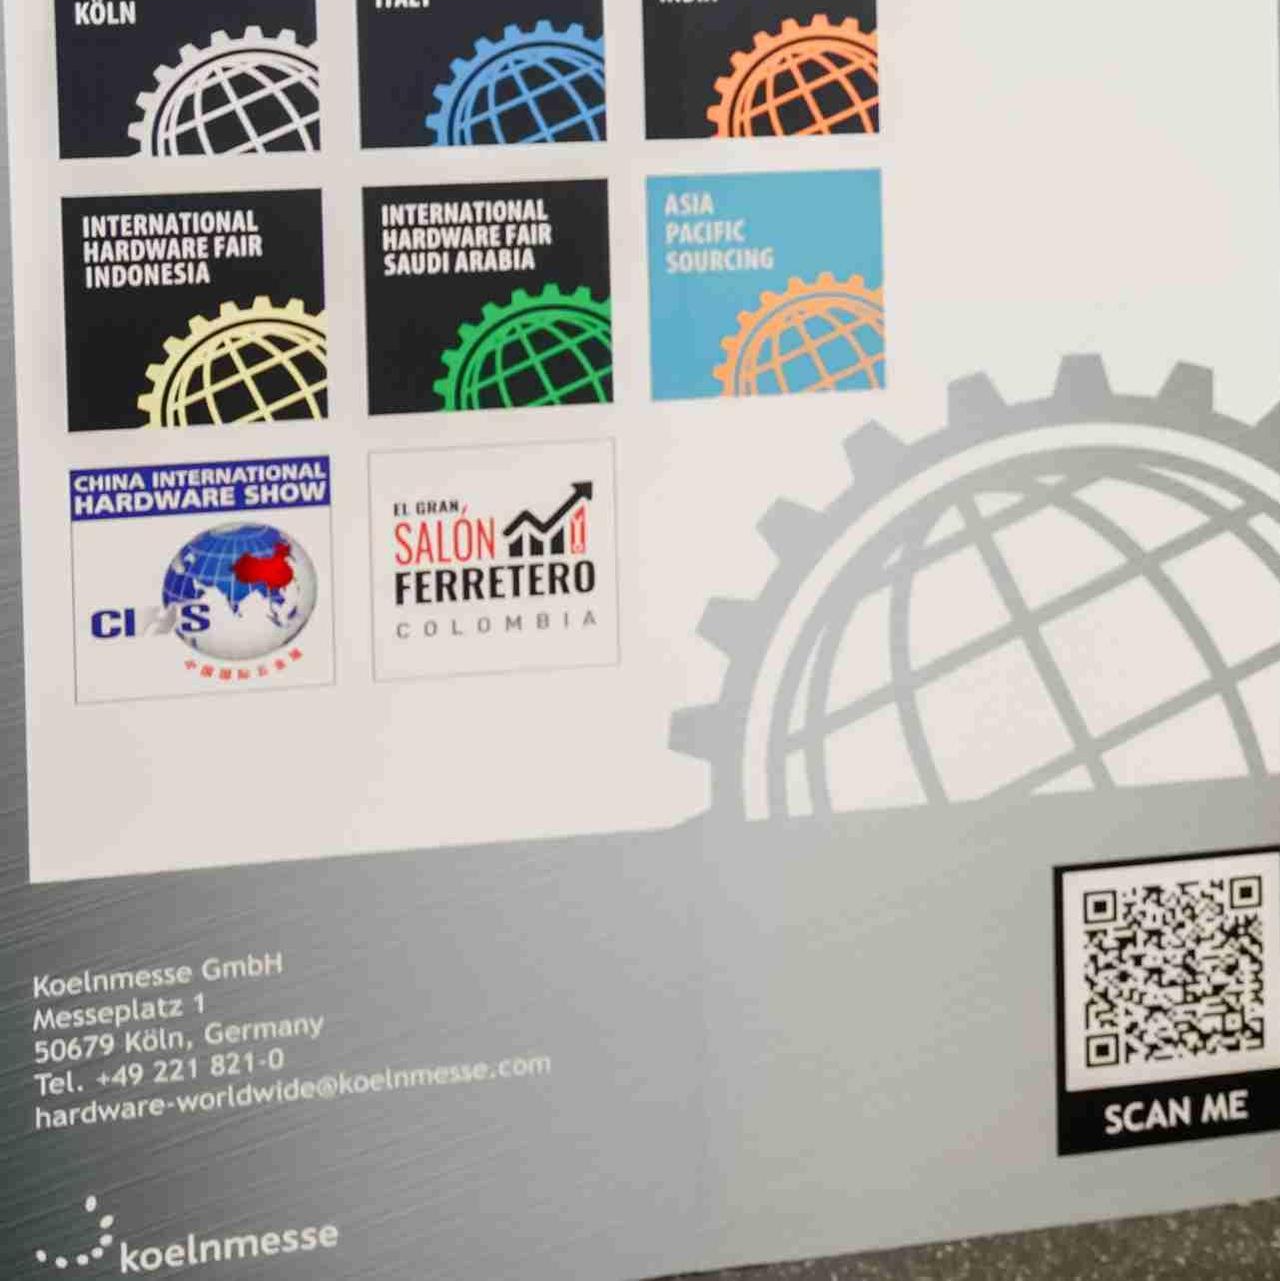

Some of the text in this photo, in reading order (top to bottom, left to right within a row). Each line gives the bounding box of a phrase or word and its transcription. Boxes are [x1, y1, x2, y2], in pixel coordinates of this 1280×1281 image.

[381, 199, 549, 226] INTERNATIONAL
[664, 192, 715, 217] ASIA
[82, 210, 259, 239] INTERNATIONAL
[382, 223, 552, 251] HARDWARE FAIR
[665, 219, 745, 245] PACIFIC
[83, 235, 263, 264] HARDWARE FAIR
[383, 248, 536, 277] SAUDI ARABIA
[666, 247, 774, 274] SOURCING
[85, 262, 211, 288] INDONESIA
[74, 462, 327, 492] CHINA INTERNATIONAL
[74, 481, 327, 515] HARDWARE SHOW
[393, 500, 459, 517] EL GRAN
[394, 504, 495, 565] SALÓN
[395, 560, 596, 605] FERRETERO
[396, 611, 597, 638] COLOMBIA
[33, 952, 283, 999] Koelnmesse GmbH
[33, 993, 205, 1033] Messeplatz 1
[35, 1016, 324, 1063] 50679 Köln, Germany
[35, 1049, 285, 1097] Tel. +49 221 821-0
[36, 1054, 551, 1129] hardware-worldwide@koelnmesse.com
[1104, 1089, 1249, 1135] SCAN ME
[119, 1224, 339, 1274] koelnmesse
